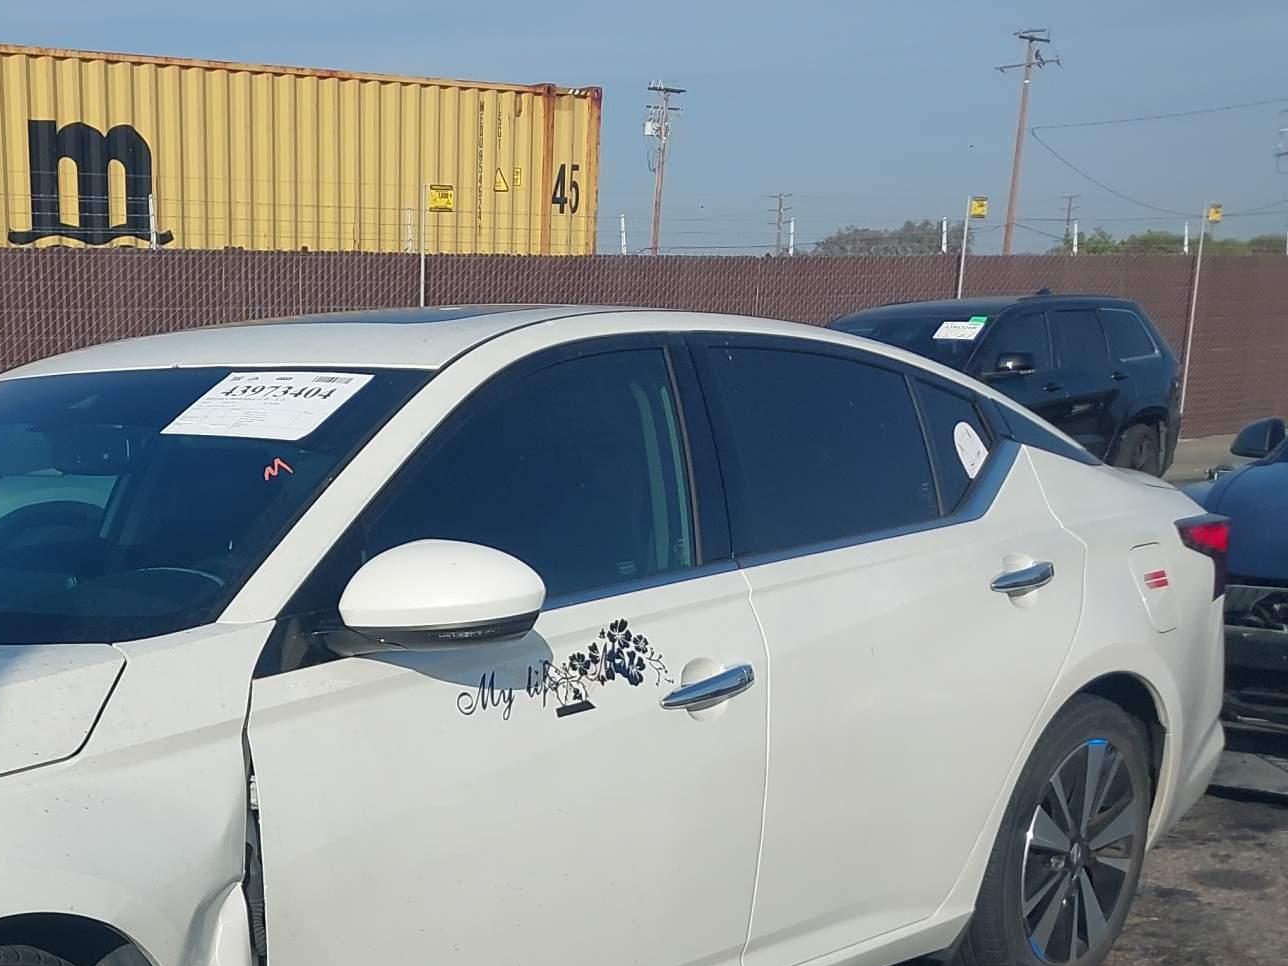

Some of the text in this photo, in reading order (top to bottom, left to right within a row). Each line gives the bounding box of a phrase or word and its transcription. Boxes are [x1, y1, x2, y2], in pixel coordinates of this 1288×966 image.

[551, 163, 580, 214] 45
[221, 385, 338, 400] 43973404
[457, 670, 514, 720] My
